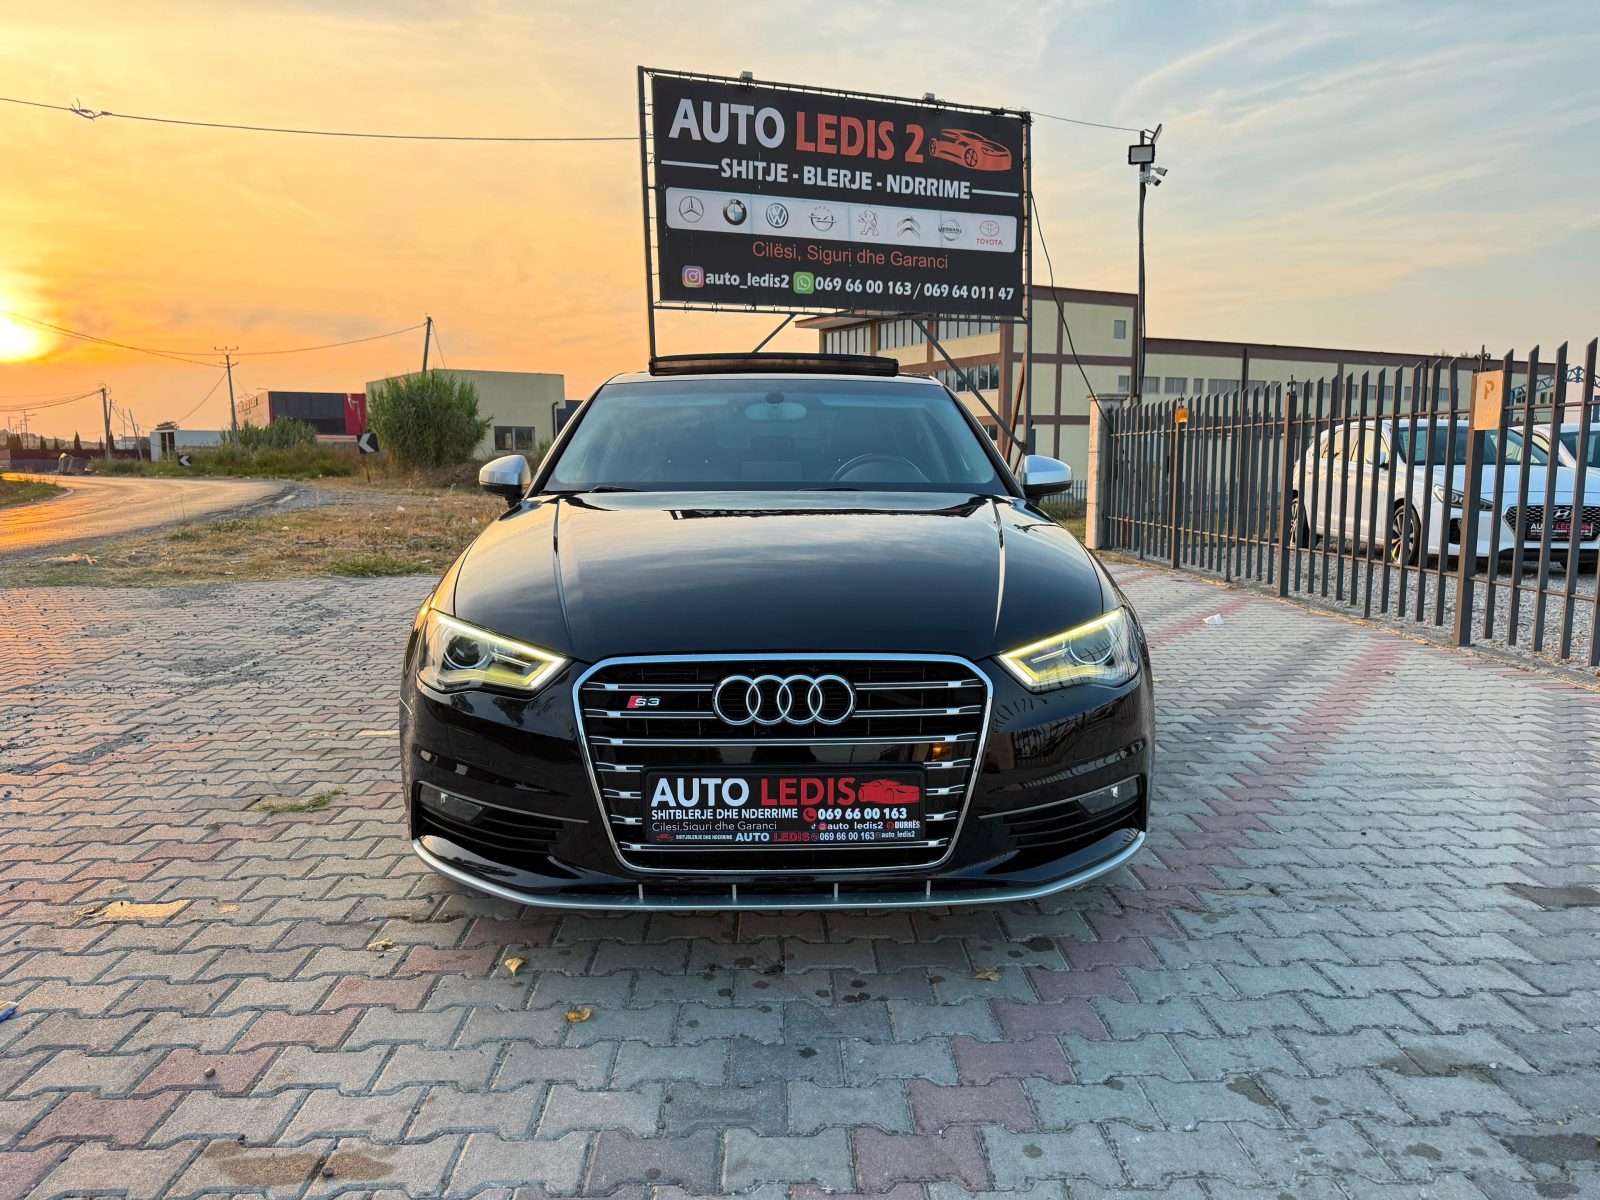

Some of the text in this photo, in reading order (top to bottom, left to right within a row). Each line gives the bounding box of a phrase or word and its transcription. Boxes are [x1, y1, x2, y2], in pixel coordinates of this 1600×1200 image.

[668, 98, 925, 163] AUTO LEDIS 2
[720, 158, 789, 183] SHITJE
[803, 165, 873, 191] BLERJE
[886, 174, 971, 200] NDRRIME
[976, 238, 1003, 246] TOYOTA
[752, 241, 948, 269] Cilësi, Siguri dhe Garanci
[705, 271, 1014, 300] auto_ledis2 069 66 00 163 / 069 64 011 47
[635, 698, 660, 706] S3
[651, 777, 856, 807] AUTO LEDIS
[651, 807, 907, 820] SHITBLERJE DHE NDERRIME 069 66 00 163
[715, 821, 734, 830] dhe
[737, 821, 777, 830] Garanci
[894, 820, 920, 829] DURRËS
[735, 832, 769, 841] AUTO
[773, 832, 810, 841] LEDIS
[820, 832, 834, 840] 069
[836, 832, 846, 840] 66
[848, 832, 858, 840] 00
[860, 832, 875, 840] 163
